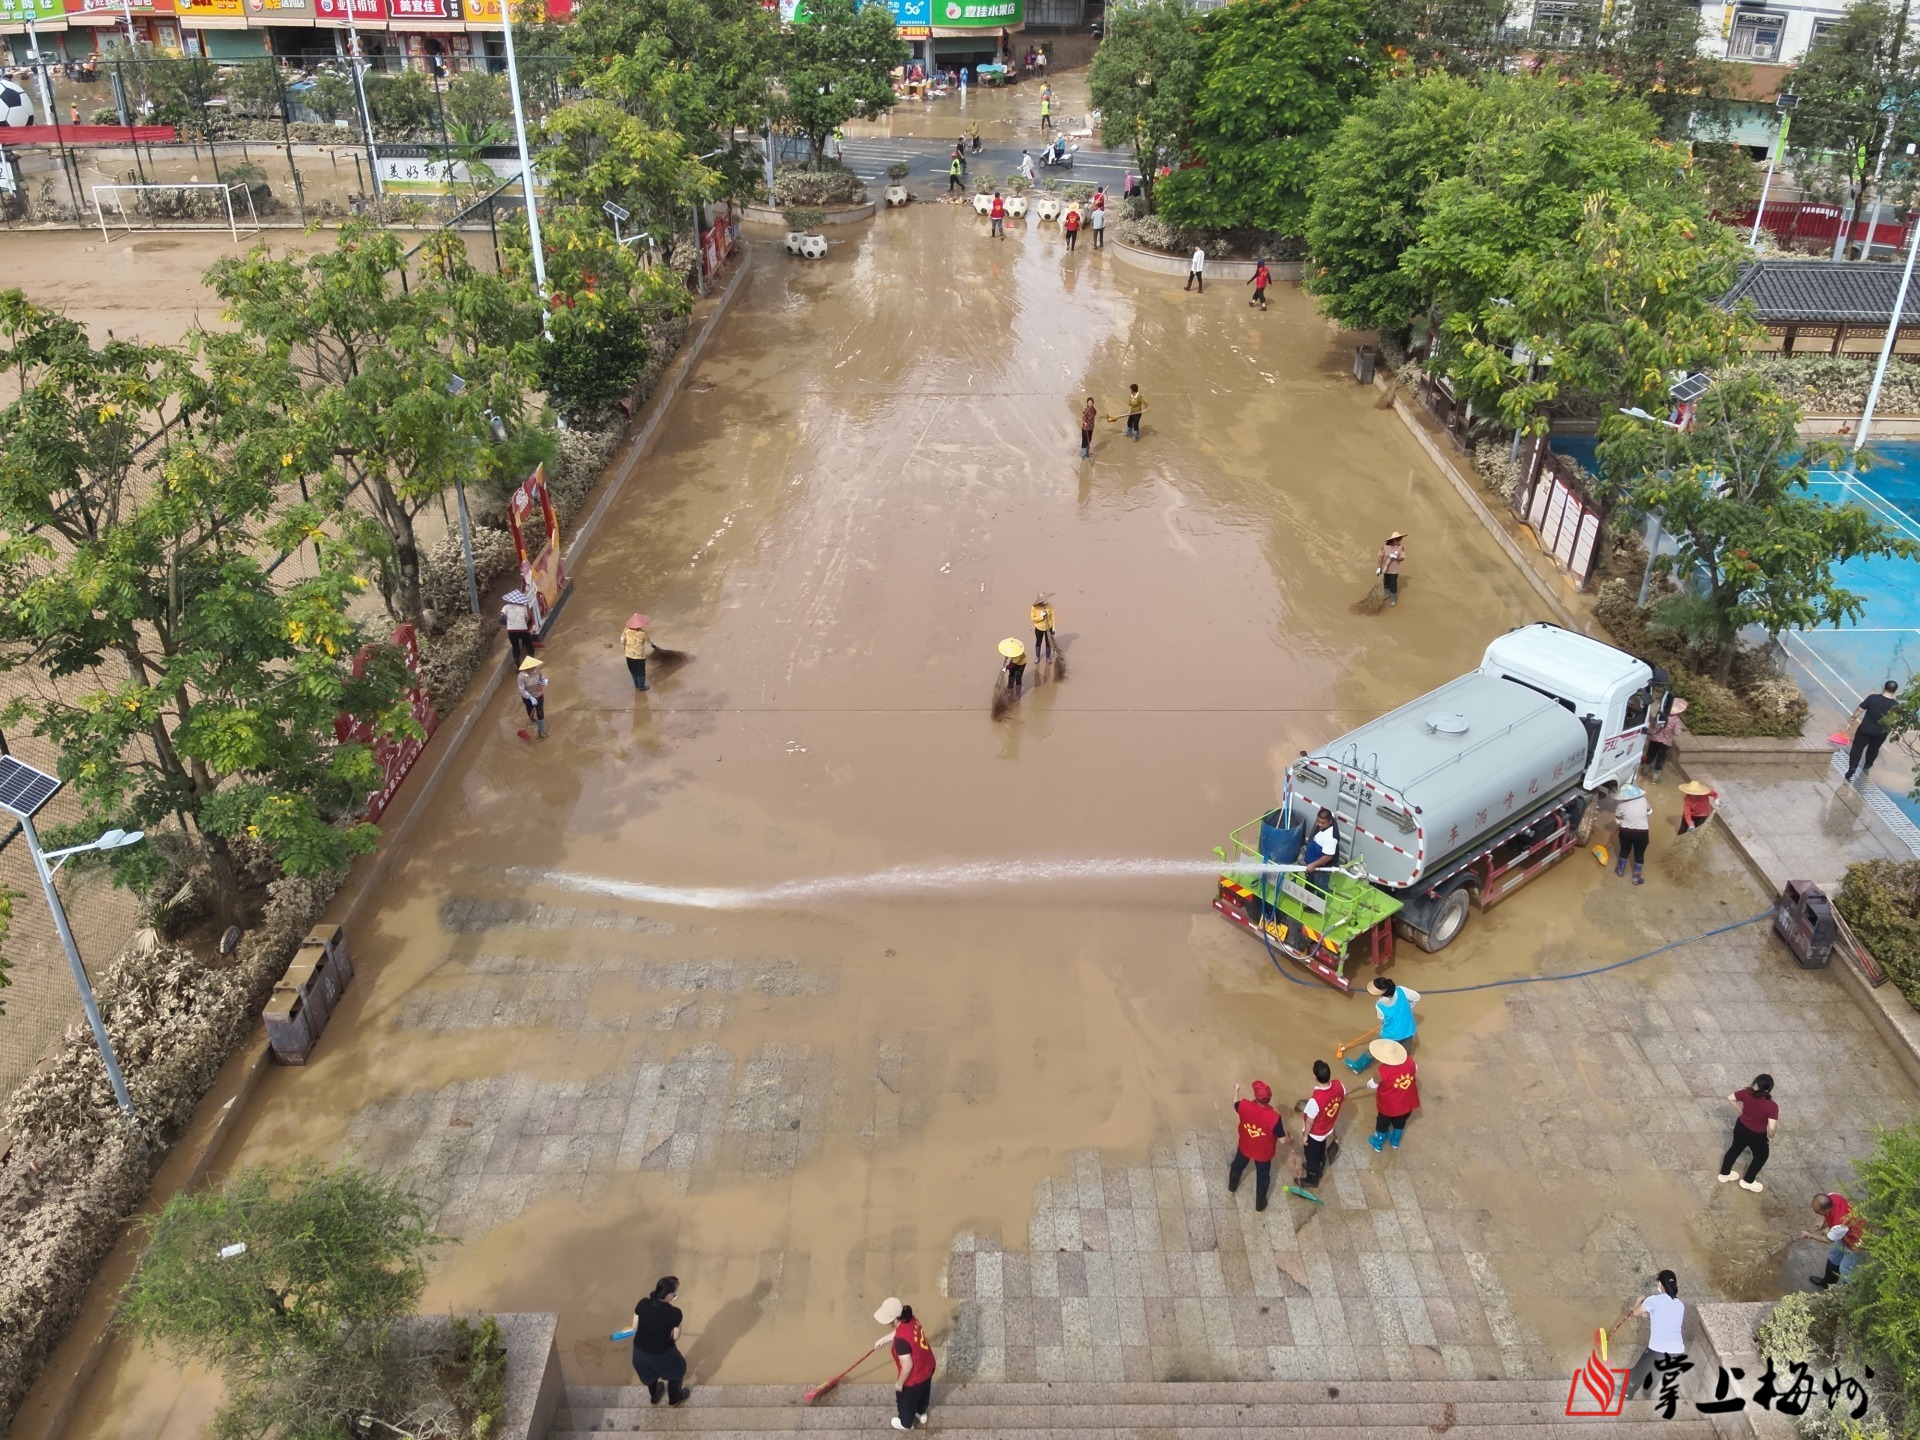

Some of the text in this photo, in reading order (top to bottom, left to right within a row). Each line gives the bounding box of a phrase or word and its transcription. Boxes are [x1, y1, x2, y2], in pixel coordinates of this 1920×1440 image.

[400, 0, 436, 12] 美宜佳
[450, 0, 459, 17] 利店
[904, 2, 921, 15] 5G
